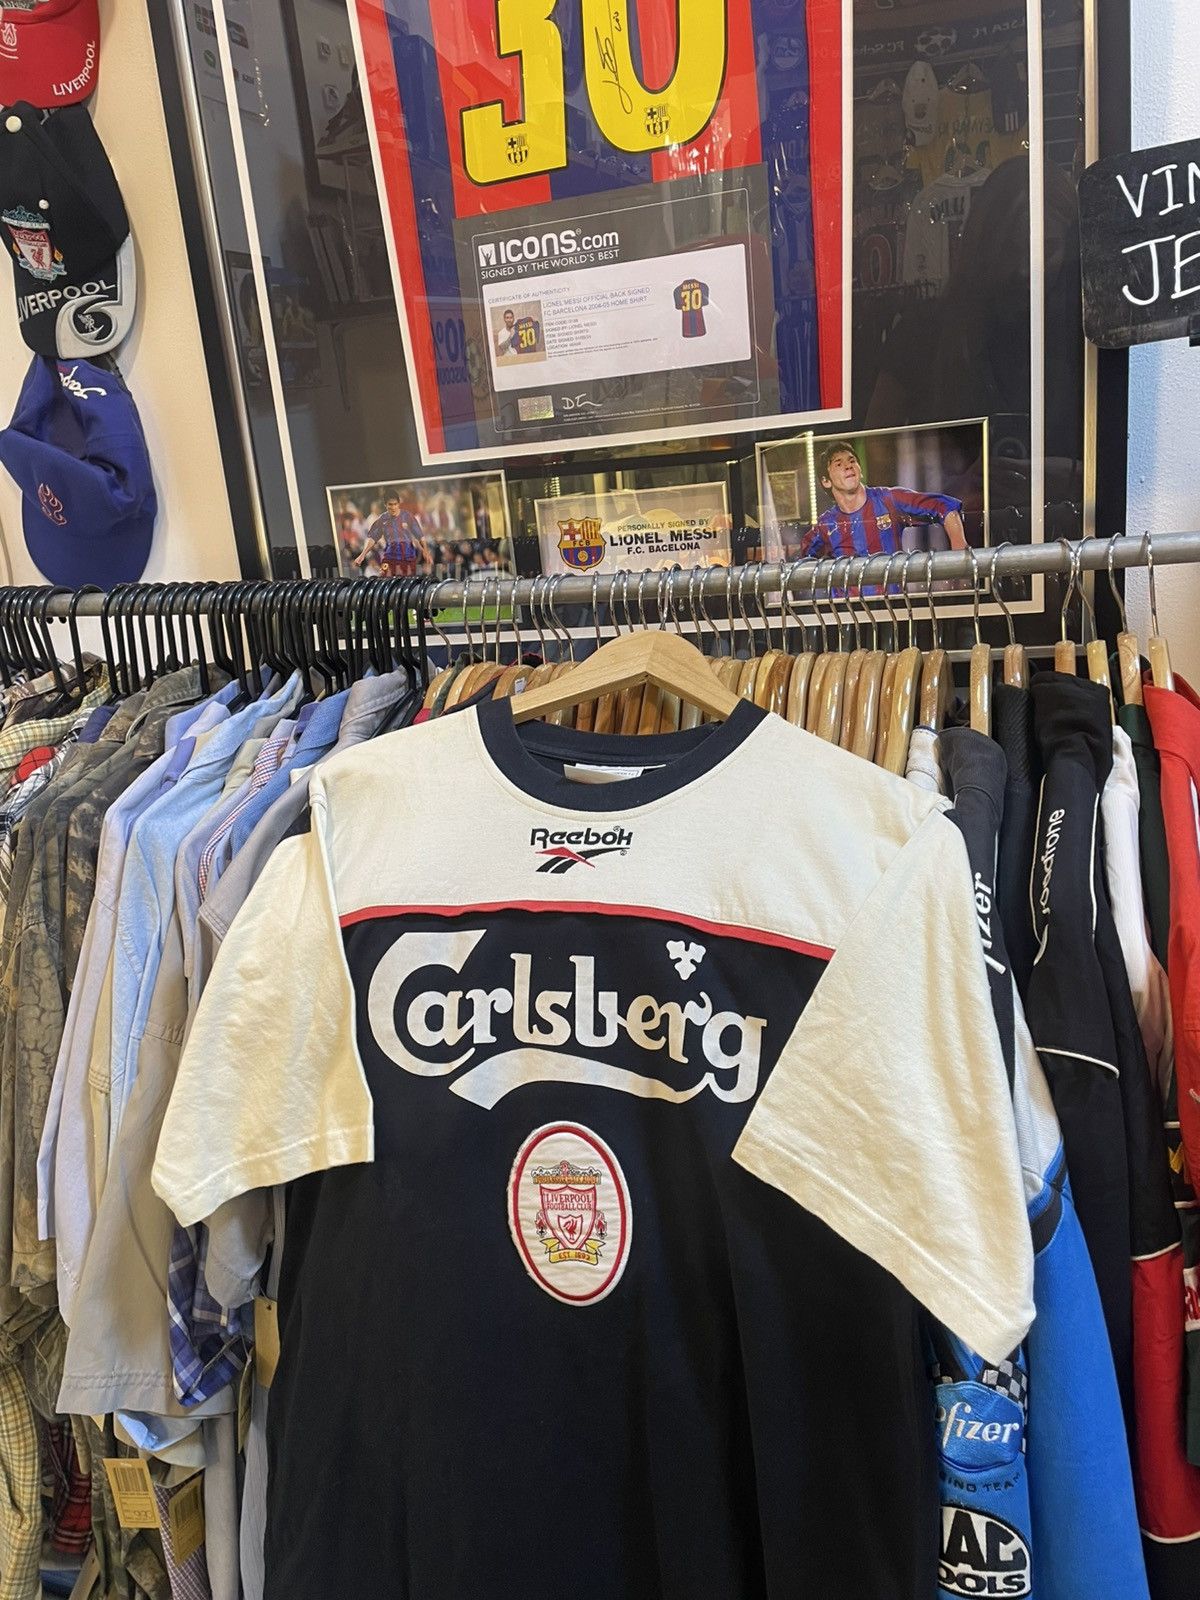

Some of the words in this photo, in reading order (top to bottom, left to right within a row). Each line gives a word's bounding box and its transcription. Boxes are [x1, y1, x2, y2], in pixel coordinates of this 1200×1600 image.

[52, 40, 96, 97] LIVERPOOL
[460, 0, 731, 187] 30
[480, 267, 518, 280] SIGNED
[517, 264, 530, 274] BY
[531, 260, 550, 272] THE
[550, 253, 596, 268] WORLD'S
[598, 248, 620, 261] BEST
[1121, 230, 1200, 306] JE
[18, 279, 116, 323] IVERPOOL
[487, 294, 522, 305] CERTIFICATE
[531, 287, 570, 298] AUTHENTICITY
[543, 299, 563, 309] LIONEL
[564, 297, 582, 306] MESSI
[583, 294, 608, 303] OFFICIAL
[609, 290, 627, 299] BACK
[627, 286, 651, 296] SIGNED
[552, 305, 587, 315] BARCELONA
[611, 298, 629, 307] HOME
[629, 295, 648, 305] SHIRT
[680, 288, 702, 312] 30
[518, 328, 536, 349] 30
[617, 521, 665, 532] PERSONALLY
[667, 519, 697, 529] SIGNED
[698, 518, 709, 526] BY
[572, 539, 592, 547] FCB
[609, 532, 664, 547] LIONEL
[669, 527, 718, 542] MESSI
[626, 546, 645, 555] F.C.
[648, 541, 701, 554] BACELONA
[529, 827, 634, 848] Reebok
[367, 928, 768, 1108] Carlsberg
[546, 1193, 592, 1204] LIVERPOOL
[546, 1202, 576, 1211] FOOTBALL
[576, 1202, 592, 1211] CLUB
[942, 1509, 1028, 1573] AC
[938, 1565, 1027, 1595] OOLS
